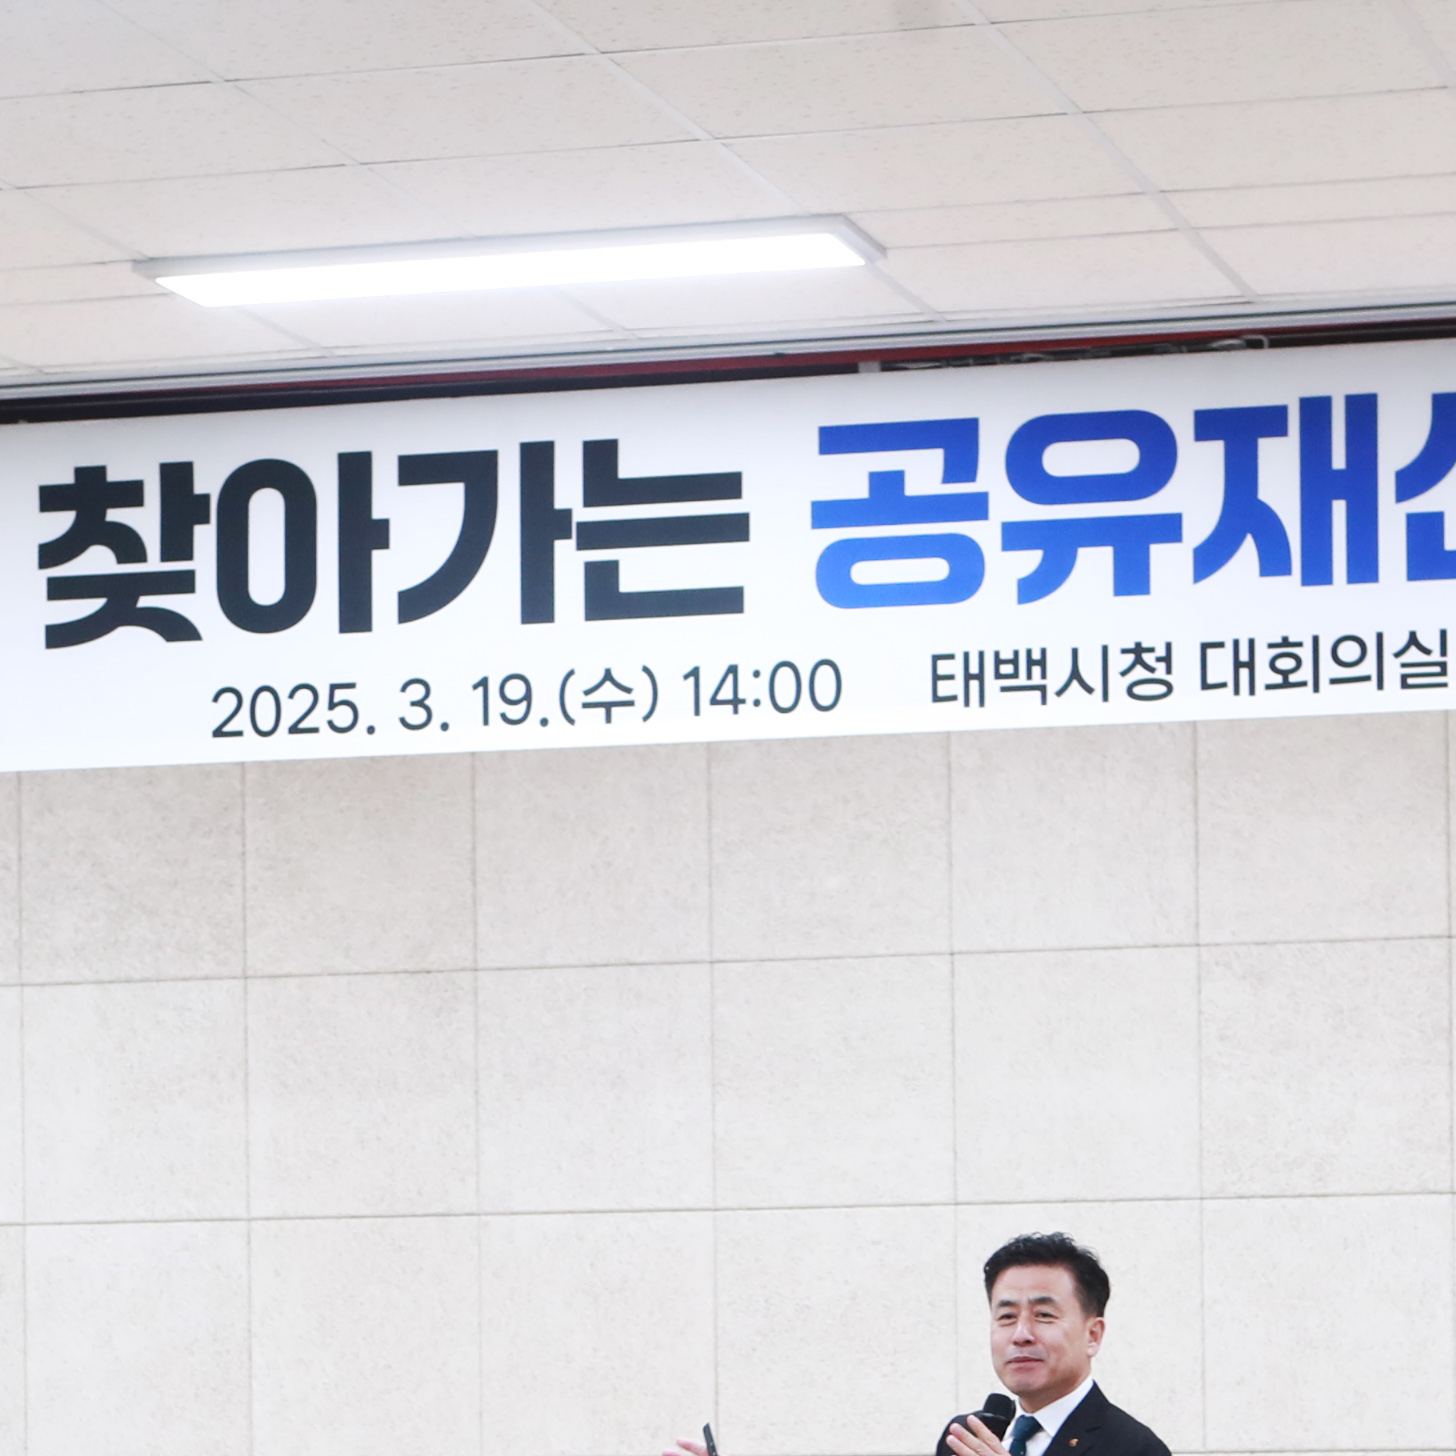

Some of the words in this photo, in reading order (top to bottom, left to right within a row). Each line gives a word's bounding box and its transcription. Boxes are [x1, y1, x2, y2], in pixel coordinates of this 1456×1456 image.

[37, 437, 751, 650] 찾아가는
[211, 681, 377, 739] 2025.
[398, 677, 448, 731] 3.
[682, 658, 843, 717] 14:00
[930, 640, 1174, 708] 태백시청
[1199, 628, 1449, 698] 대회의실
